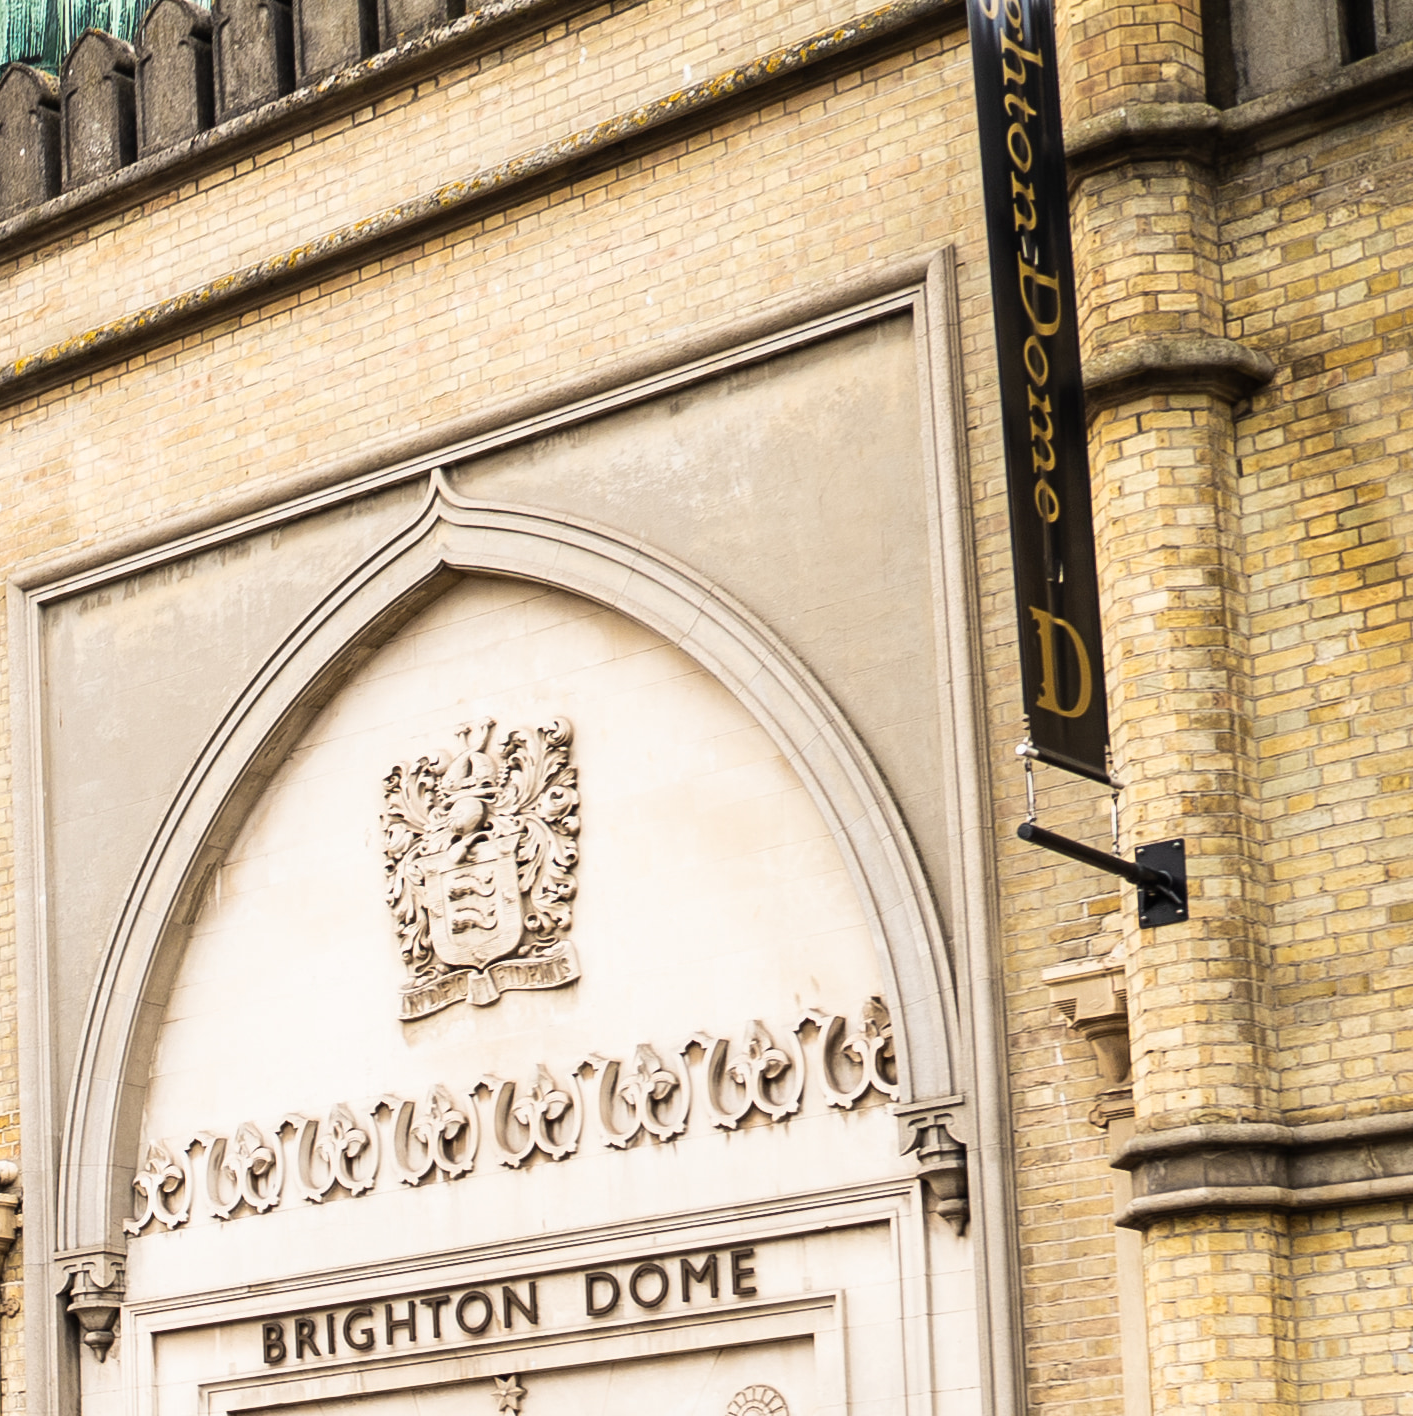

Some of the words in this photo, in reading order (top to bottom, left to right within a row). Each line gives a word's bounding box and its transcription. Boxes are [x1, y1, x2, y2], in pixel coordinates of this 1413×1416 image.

[1017, 250, 1061, 523] Dome
[1028, 606, 1092, 718] D
[261, 1280, 539, 1365] BRIGHTON
[584, 1246, 759, 1319] DOME
